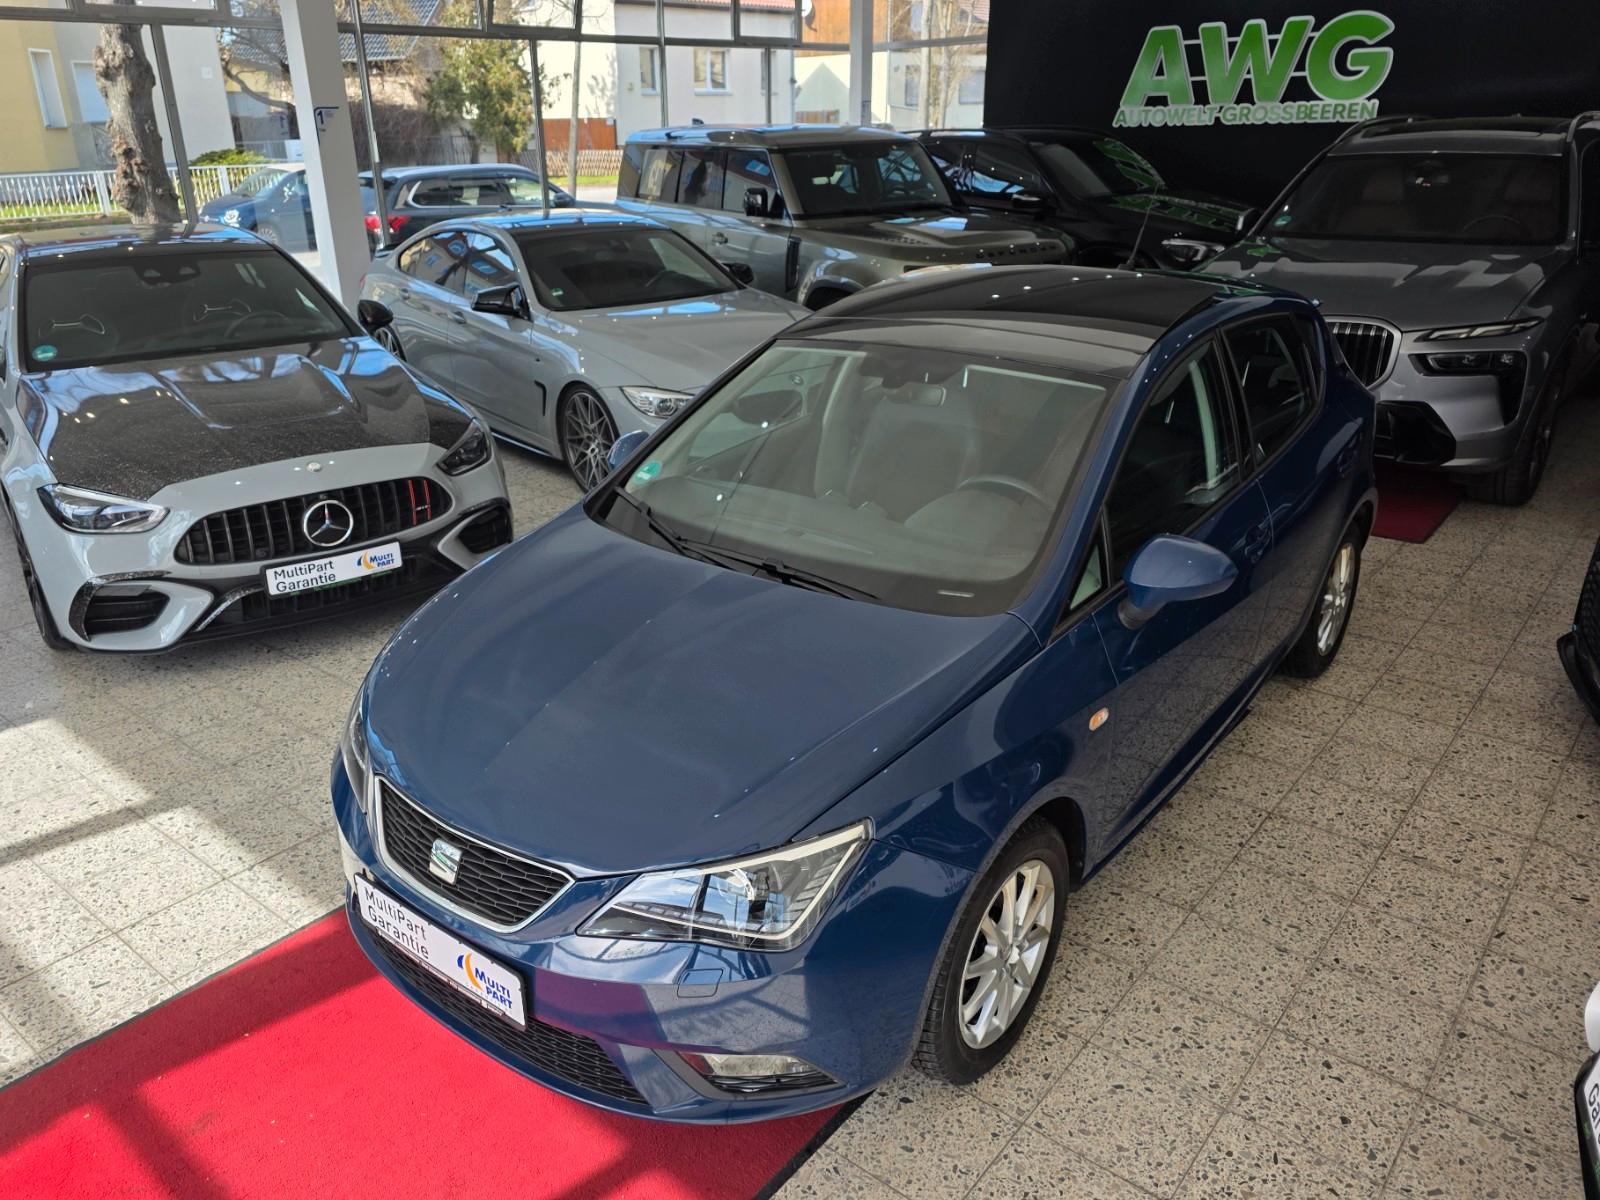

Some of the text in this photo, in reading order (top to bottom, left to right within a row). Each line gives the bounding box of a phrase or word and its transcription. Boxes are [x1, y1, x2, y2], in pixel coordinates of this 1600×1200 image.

[1120, 10, 1395, 107] AWG
[1220, 99, 1379, 124] GROSSBEEREN
[274, 560, 334, 580] MultiPart
[377, 558, 395, 568] PART
[276, 573, 336, 592] Garantie
[364, 887, 427, 940] MultiPart
[368, 905, 429, 960] Garantie
[475, 967, 511, 998] MULTI
[485, 985, 513, 1009] PART
